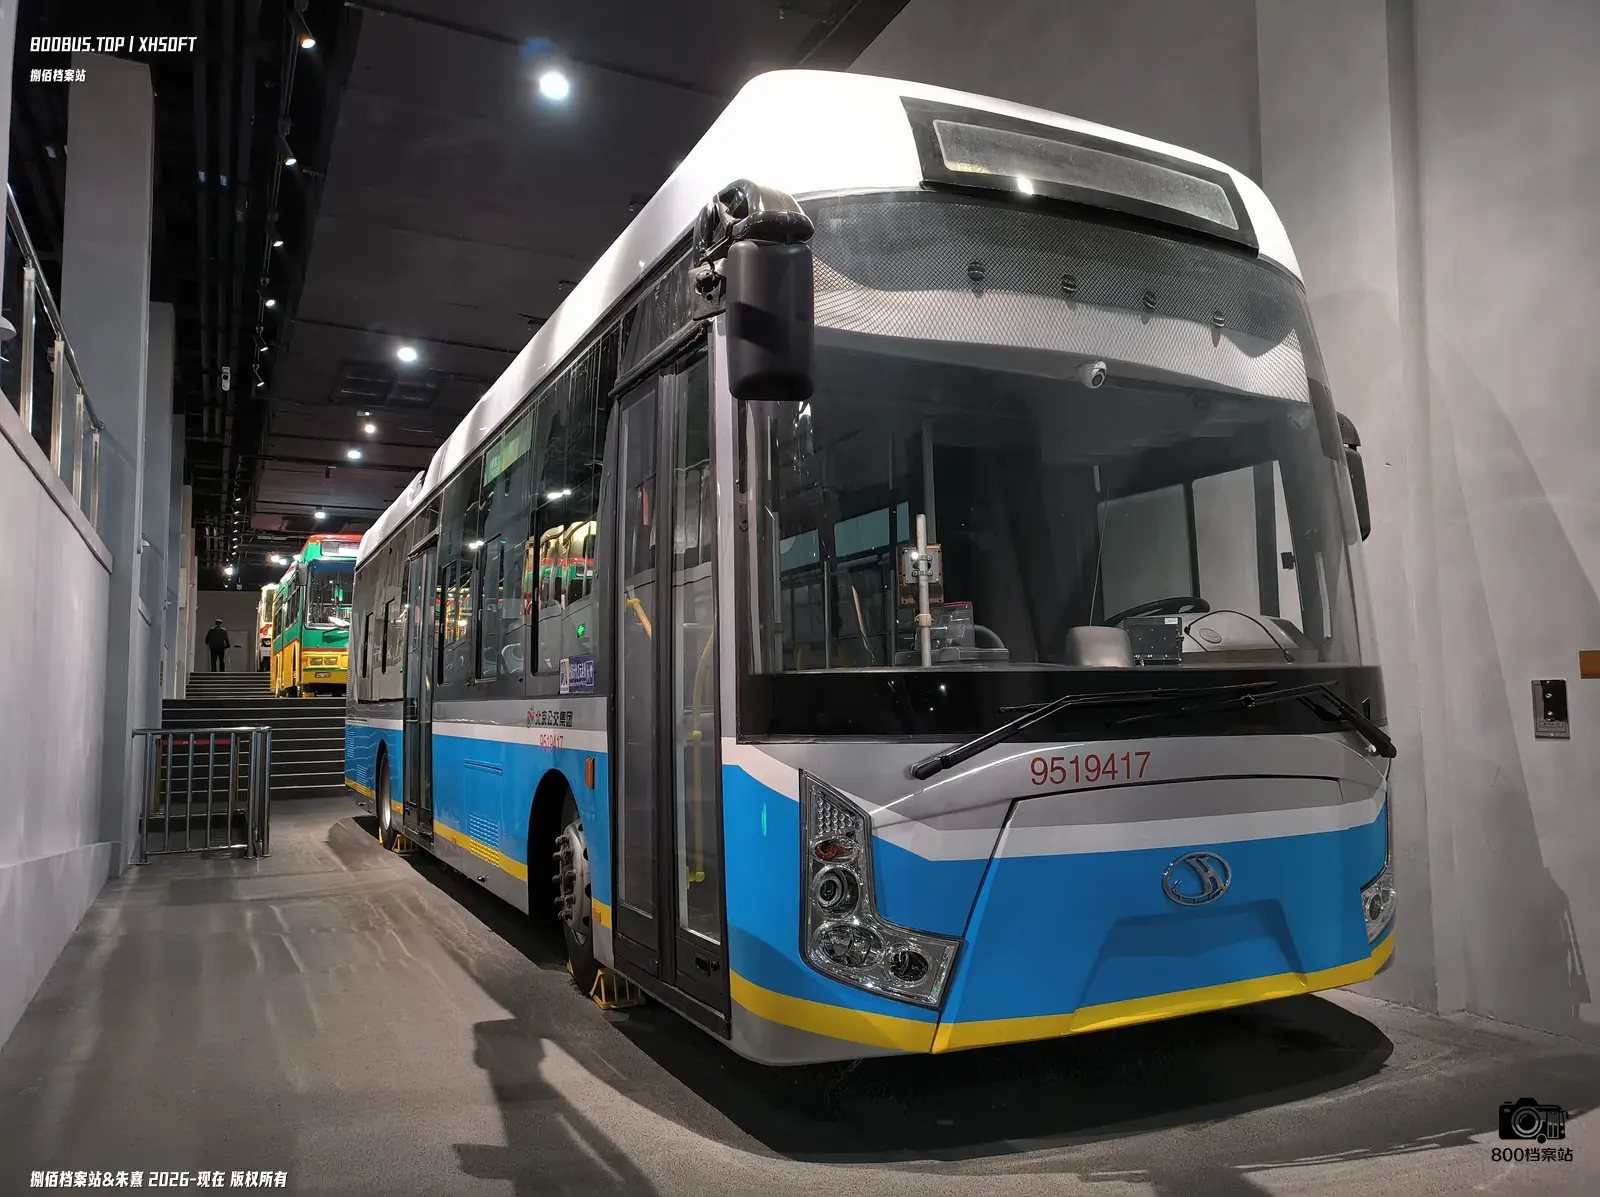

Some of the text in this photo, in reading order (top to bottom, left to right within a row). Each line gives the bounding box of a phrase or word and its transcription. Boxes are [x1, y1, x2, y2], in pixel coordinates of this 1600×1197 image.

[535, 710, 573, 727] 北京公交集团
[540, 734, 563, 752] 9519417
[1030, 751, 1151, 785] 9519417
